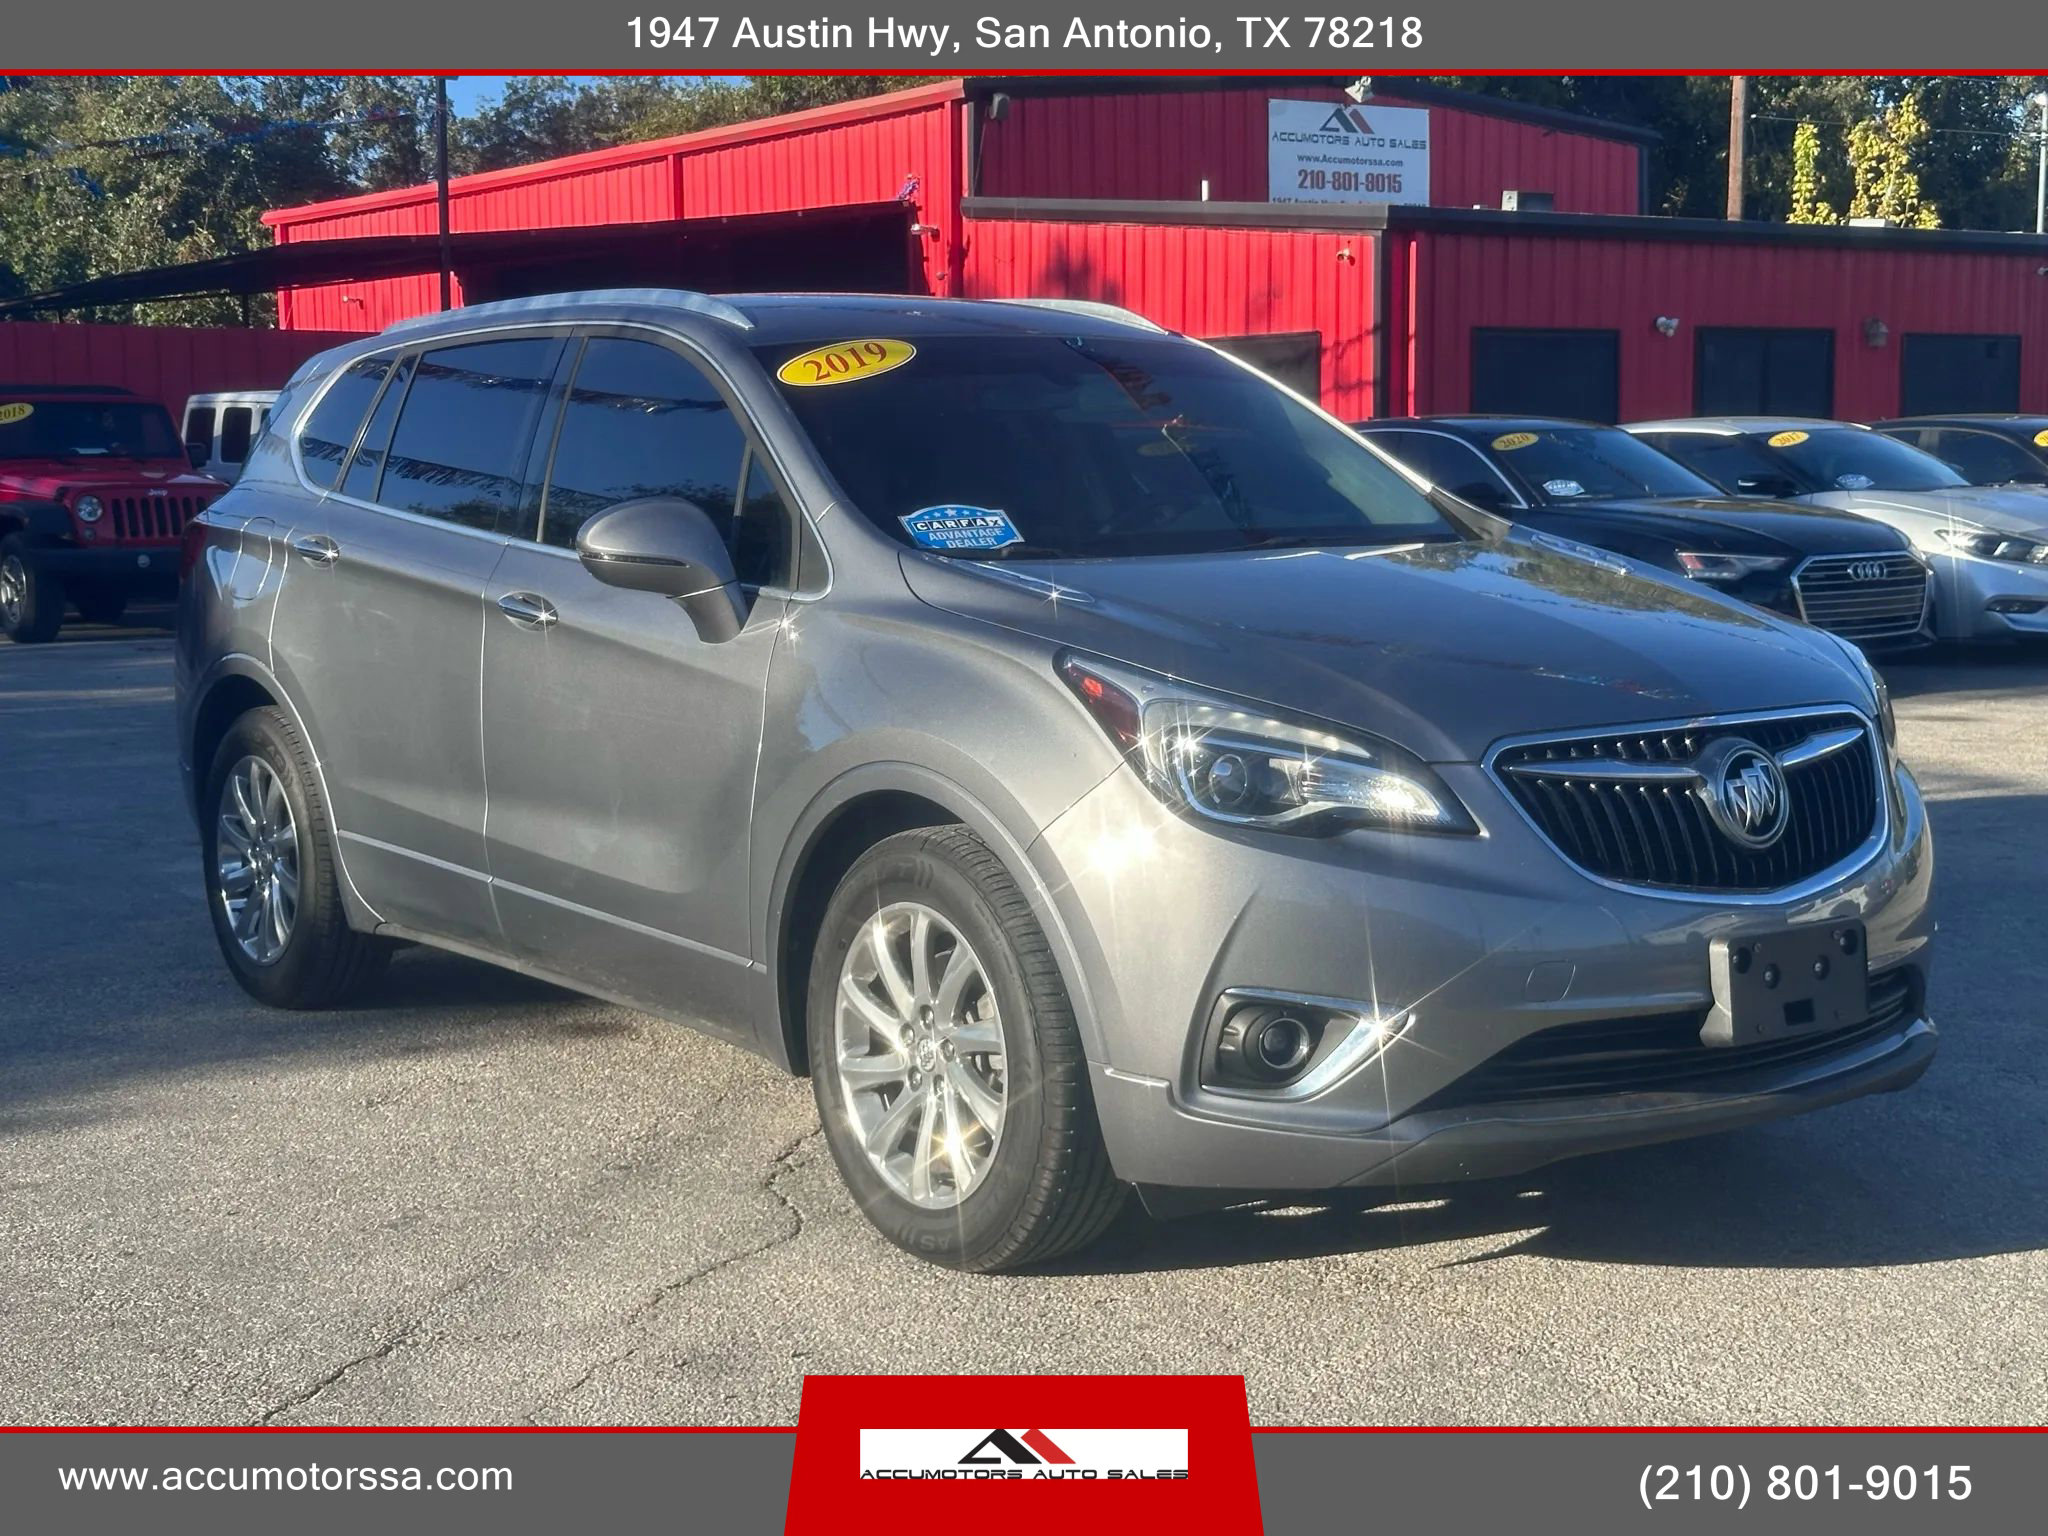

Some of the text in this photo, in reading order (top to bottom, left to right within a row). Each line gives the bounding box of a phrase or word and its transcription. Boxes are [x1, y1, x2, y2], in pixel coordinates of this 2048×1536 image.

[1272, 131, 1427, 150] ACCUMOTORS AUTO SALES
[1297, 154, 1404, 167] www.Accumotorssa.com
[1298, 169, 1402, 193] 210-801-9015
[803, 342, 887, 382] 2019
[914, 517, 1005, 531] CARFAX
[928, 528, 1003, 541] ADVANTAGE
[946, 538, 998, 549] DEALER
